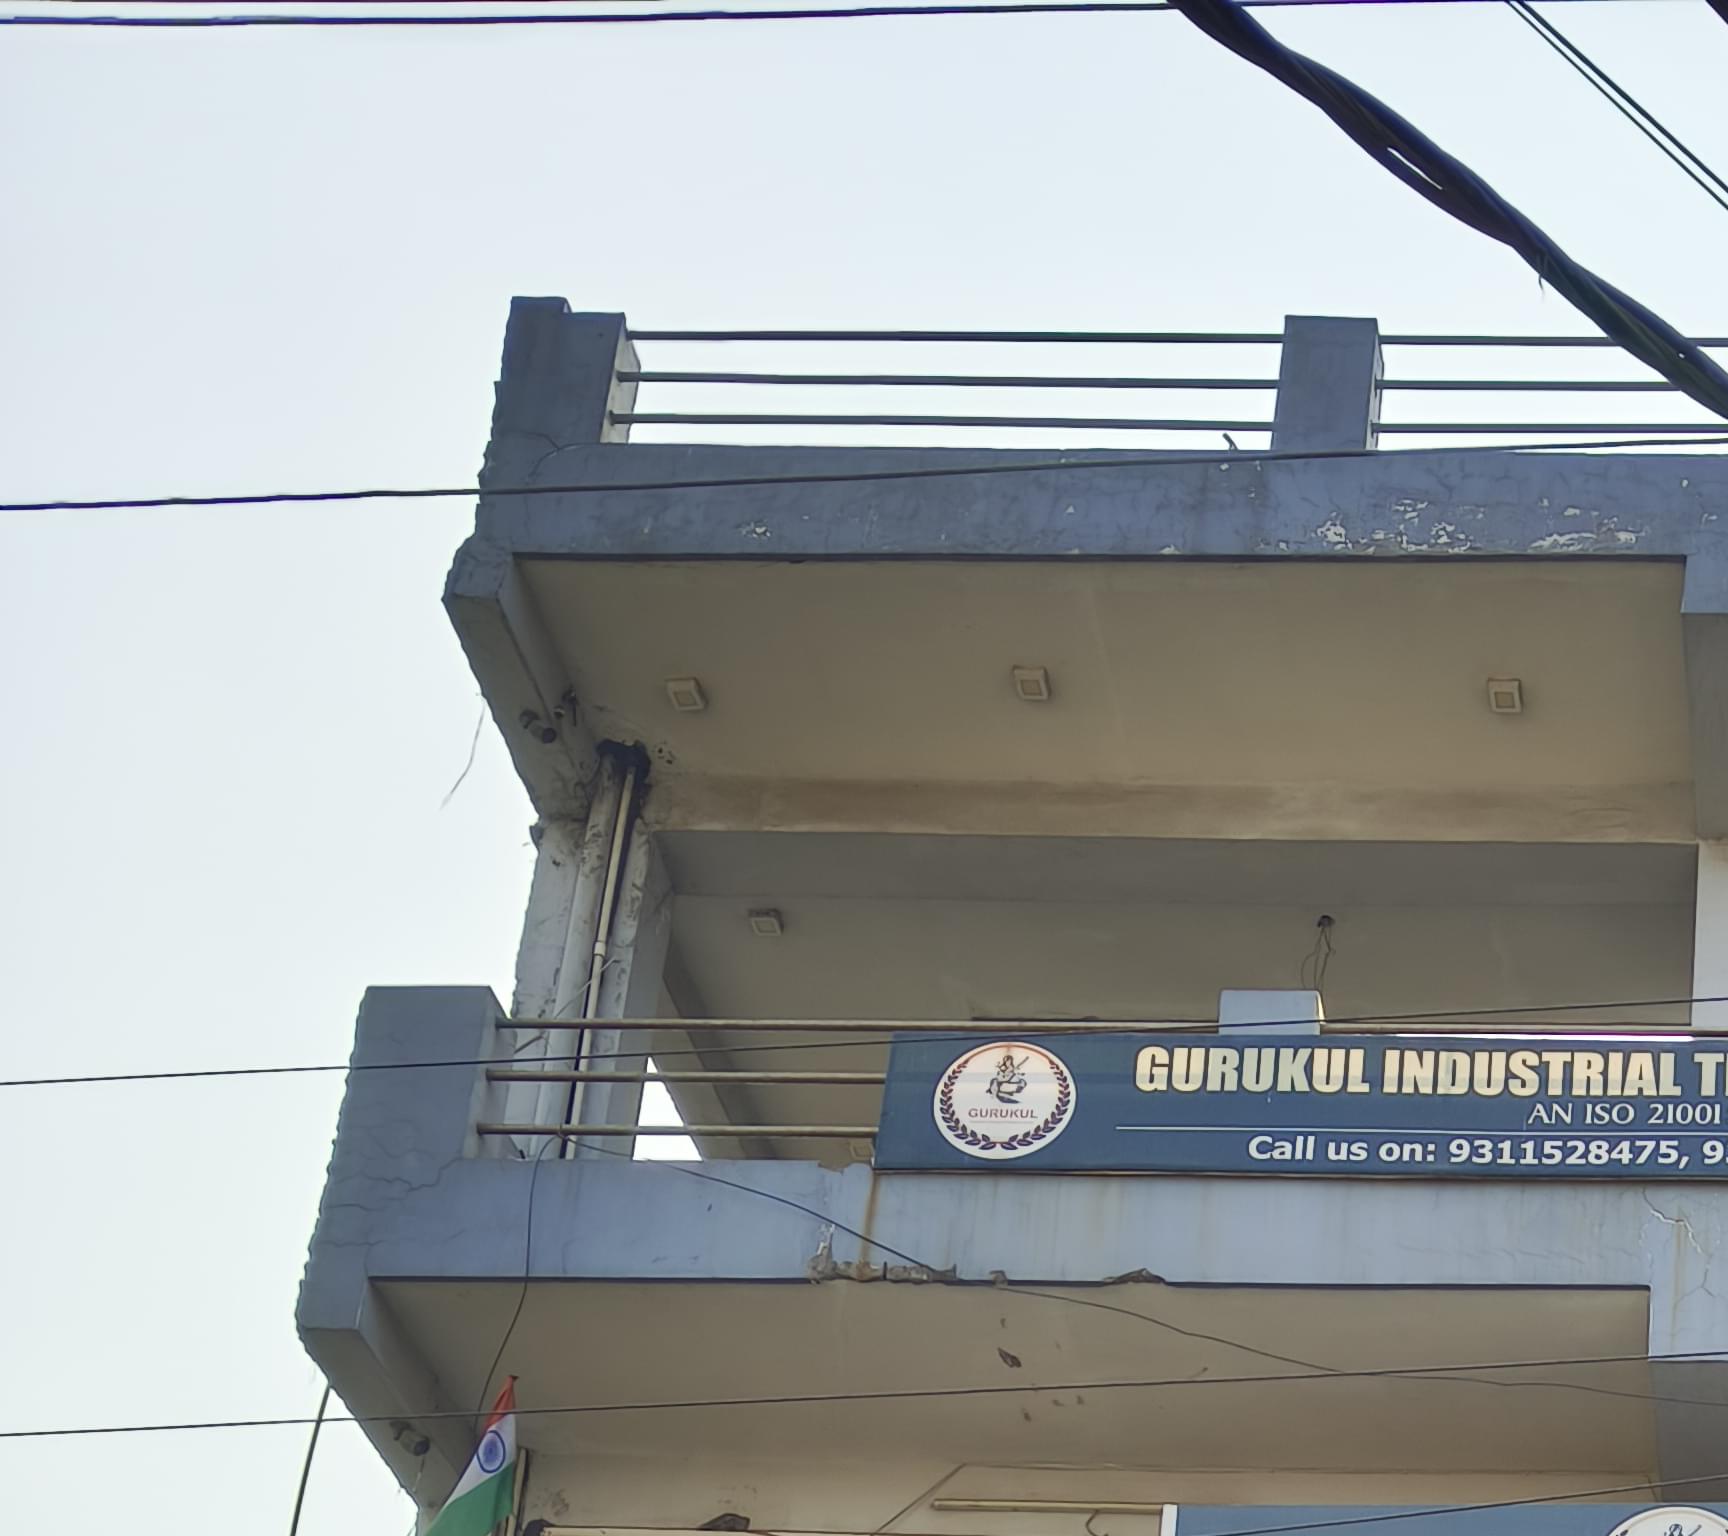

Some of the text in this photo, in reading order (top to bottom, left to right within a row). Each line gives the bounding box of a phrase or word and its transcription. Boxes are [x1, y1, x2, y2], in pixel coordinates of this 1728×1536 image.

[1135, 1046, 1369, 1093] GURUKUL
[1383, 1049, 1682, 1096] INDUSTRIAL
[968, 1107, 1038, 1119] GURUKUL
[1528, 1104, 1572, 1124] AN
[1585, 1103, 1635, 1124] ISO
[1248, 1135, 1314, 1161] Call
[1327, 1142, 1368, 1161] us
[1378, 1142, 1435, 1162] on:
[1448, 1139, 1690, 1169] 9311528475,
